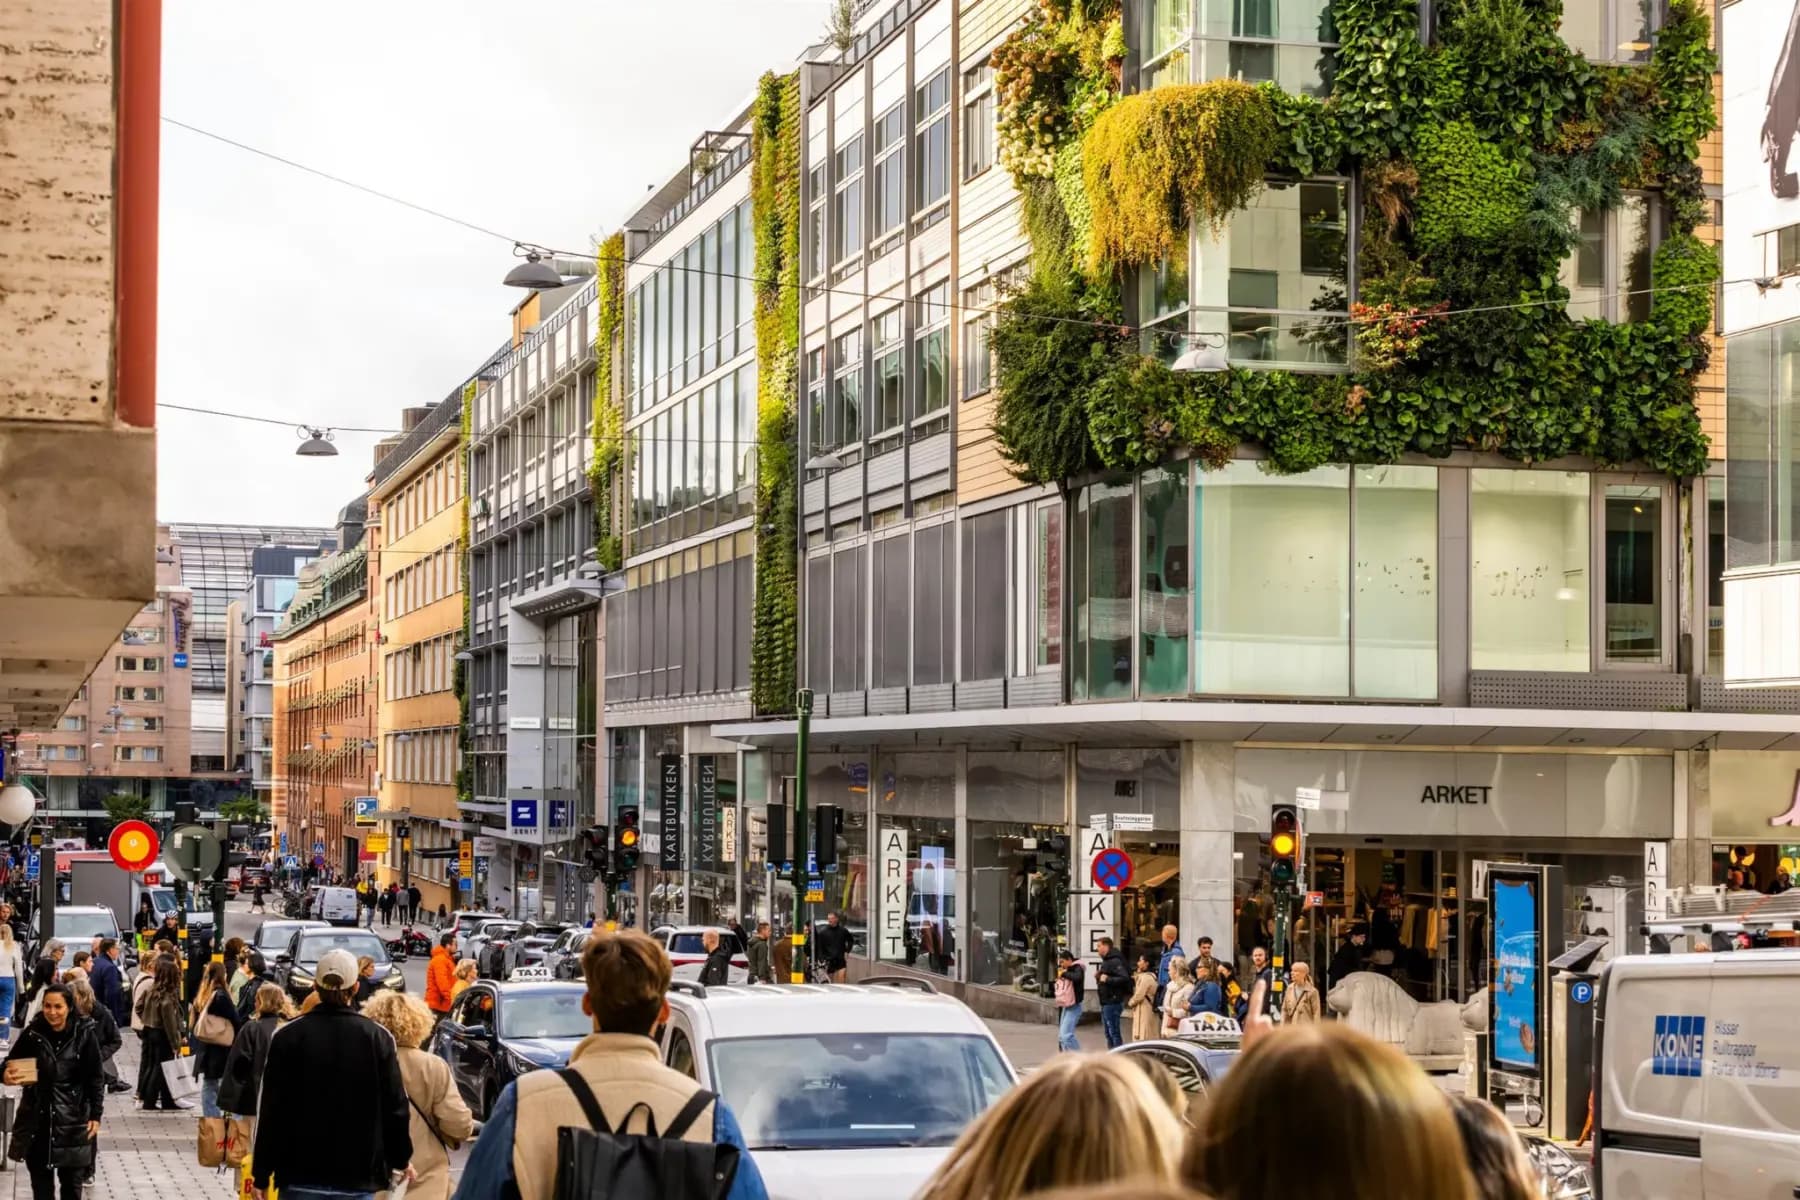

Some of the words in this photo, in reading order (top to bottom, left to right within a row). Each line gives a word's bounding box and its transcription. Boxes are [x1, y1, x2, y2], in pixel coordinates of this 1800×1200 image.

[665, 764, 677, 862] KARTBUTIKEN
[1420, 785, 1492, 804] ARKET
[726, 809, 734, 860] ARKET
[886, 832, 903, 956] ARKET
[1089, 832, 1106, 976] AKET
[1577, 988, 1587, 1000] P
[1189, 1019, 1236, 1031] TAXI
[1654, 1033, 1704, 1058] KONE
